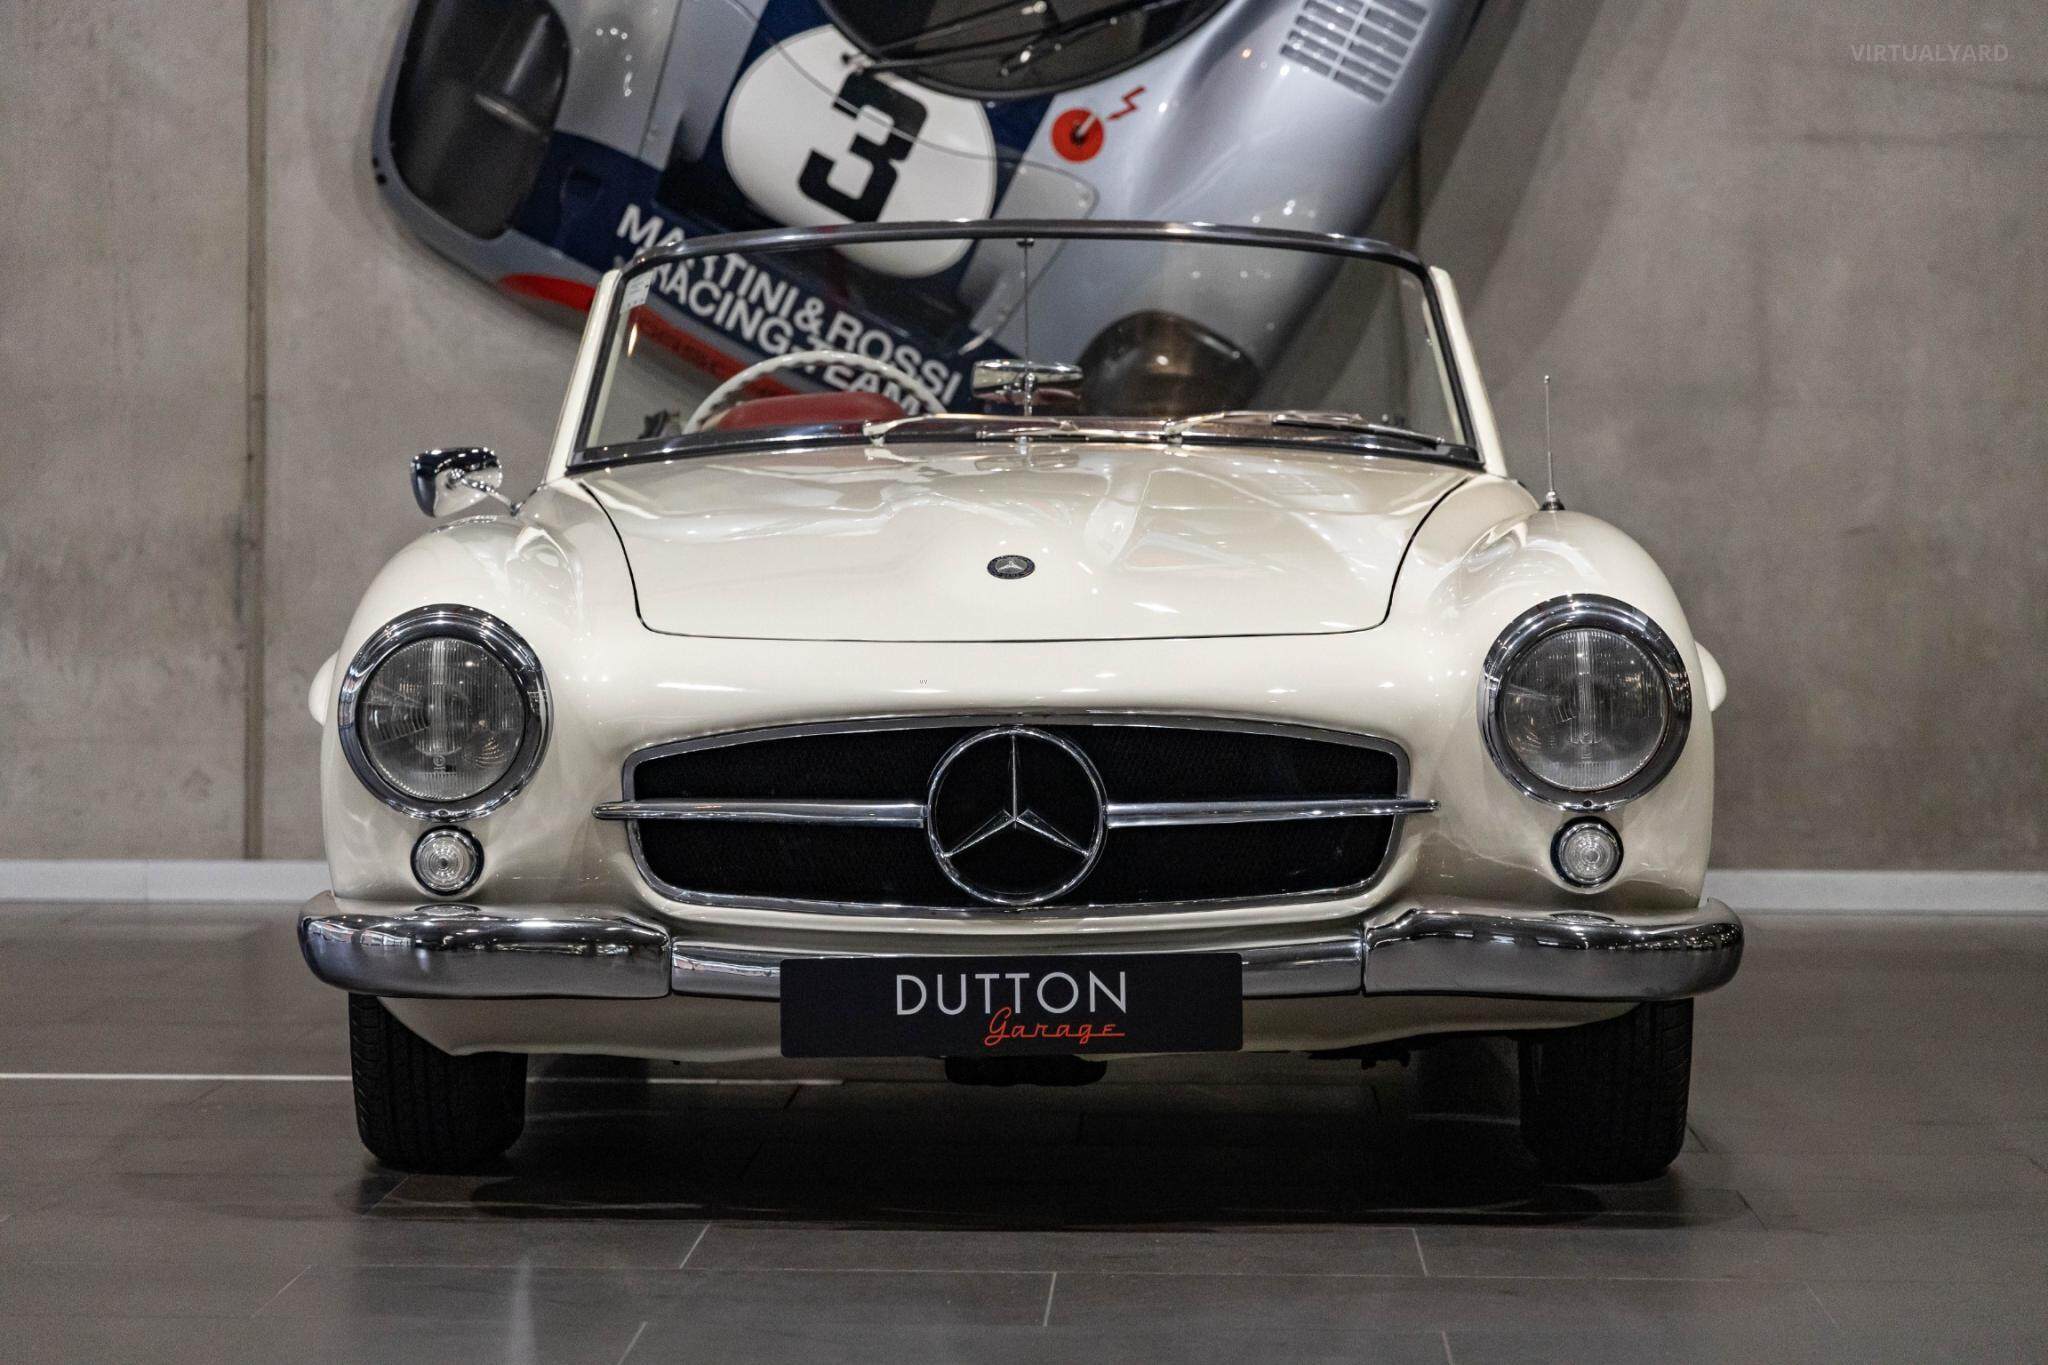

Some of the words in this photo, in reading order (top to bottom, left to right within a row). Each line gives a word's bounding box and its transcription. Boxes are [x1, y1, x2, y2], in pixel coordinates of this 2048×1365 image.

[799, 70, 927, 222] 3
[896, 970, 1127, 1015] DUTTON
[984, 1007, 1125, 1047] Garage
